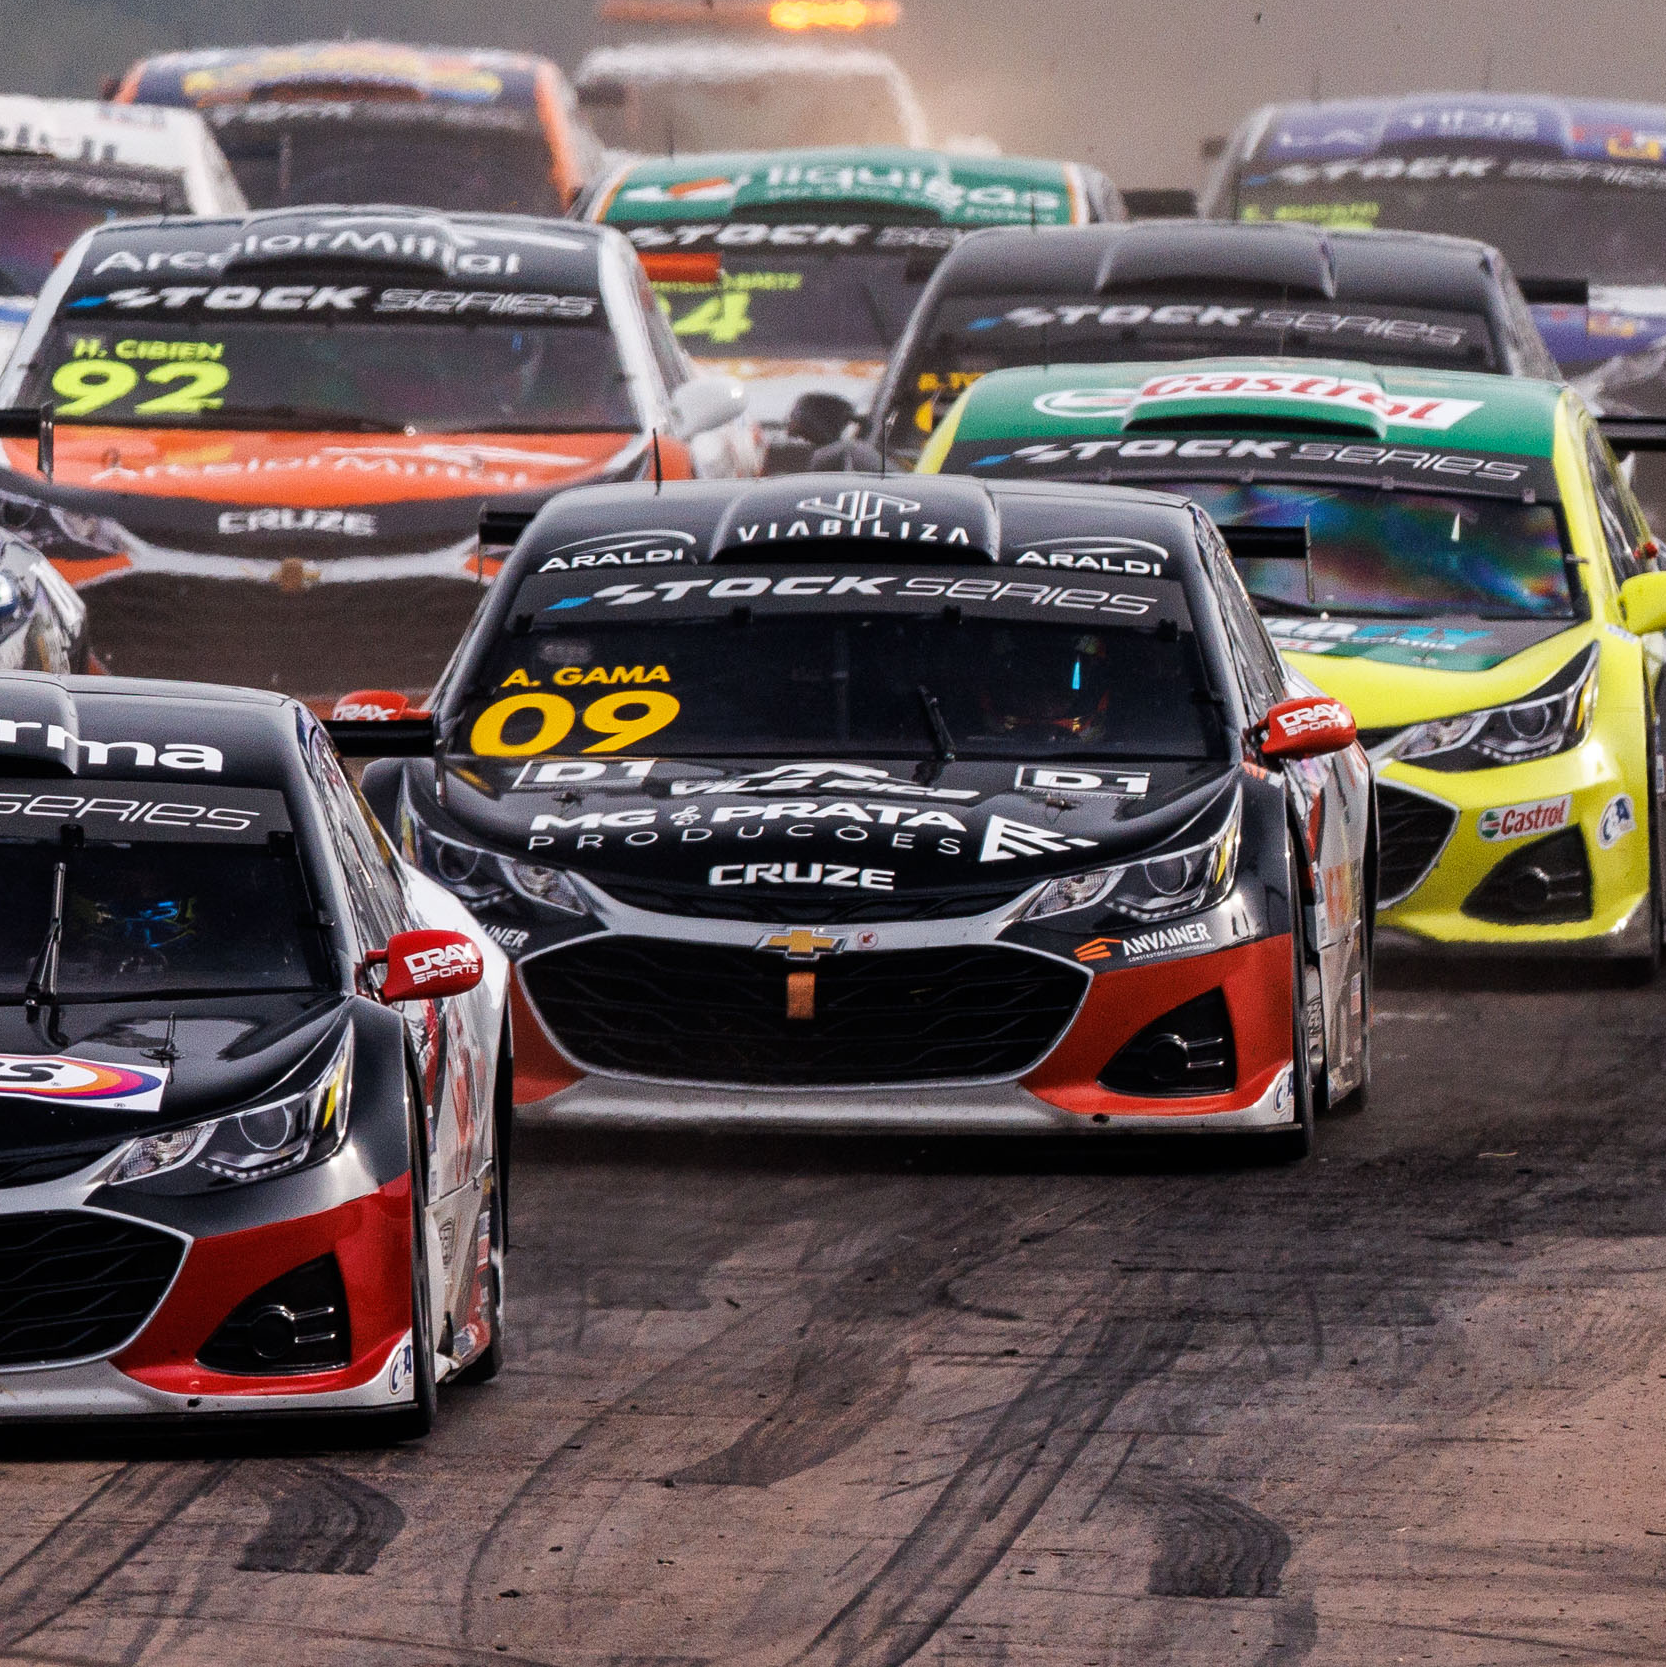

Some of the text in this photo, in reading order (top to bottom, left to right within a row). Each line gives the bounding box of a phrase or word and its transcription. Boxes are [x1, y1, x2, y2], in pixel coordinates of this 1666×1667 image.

[107, 285, 372, 311] STOCK
[1003, 303, 1255, 328] STOCK
[72, 337, 226, 361] H. CIBIEN
[51, 358, 230, 416] 92
[1141, 375, 1442, 421] Castrol
[1011, 439, 1290, 464] STOCK
[217, 507, 378, 536] CRUZE
[736, 518, 970, 545] VIABILIZA
[537, 547, 684, 573] ARALDI
[1015, 550, 1162, 576] ARALDI
[592, 576, 900, 607] STOCK
[500, 664, 672, 689] A. GAMA
[469, 690, 681, 758] 09
[532, 760, 657, 784] D1
[1033, 768, 1151, 794] D1
[529, 809, 659, 831] MG
[709, 802, 967, 832] PRATA
[1500, 798, 1567, 835] Castrol
[708, 861, 896, 891] CRUZE
[1122, 922, 1212, 957] ANVAINER
[403, 942, 478, 975] DRAX
[412, 963, 479, 986] SPORTS
